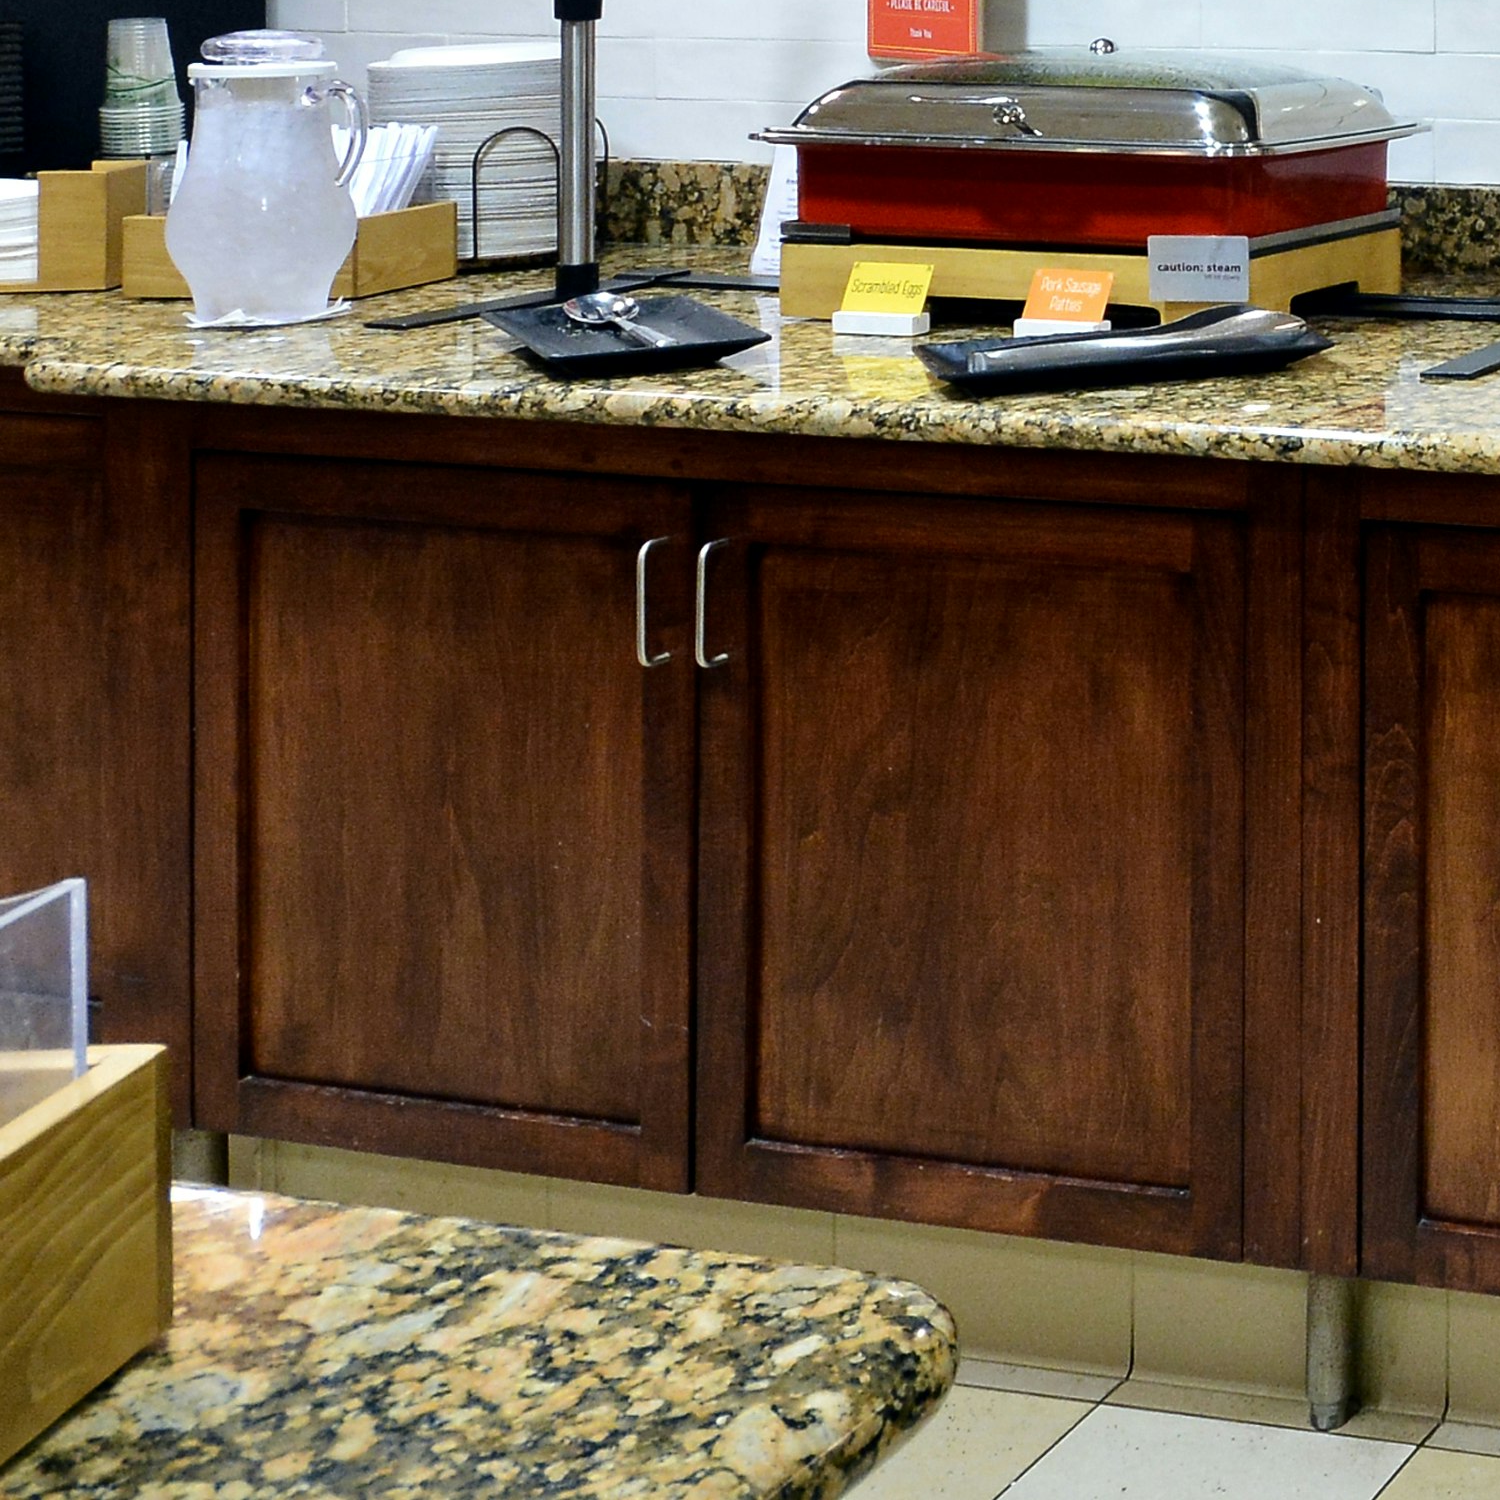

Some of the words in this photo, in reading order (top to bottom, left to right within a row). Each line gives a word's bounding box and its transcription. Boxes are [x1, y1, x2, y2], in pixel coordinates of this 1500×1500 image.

[1157, 262, 1204, 273] caution:
[1207, 263, 1242, 273] steam
[851, 278, 901, 295] Scrambled
[902, 280, 924, 299] Eggs
